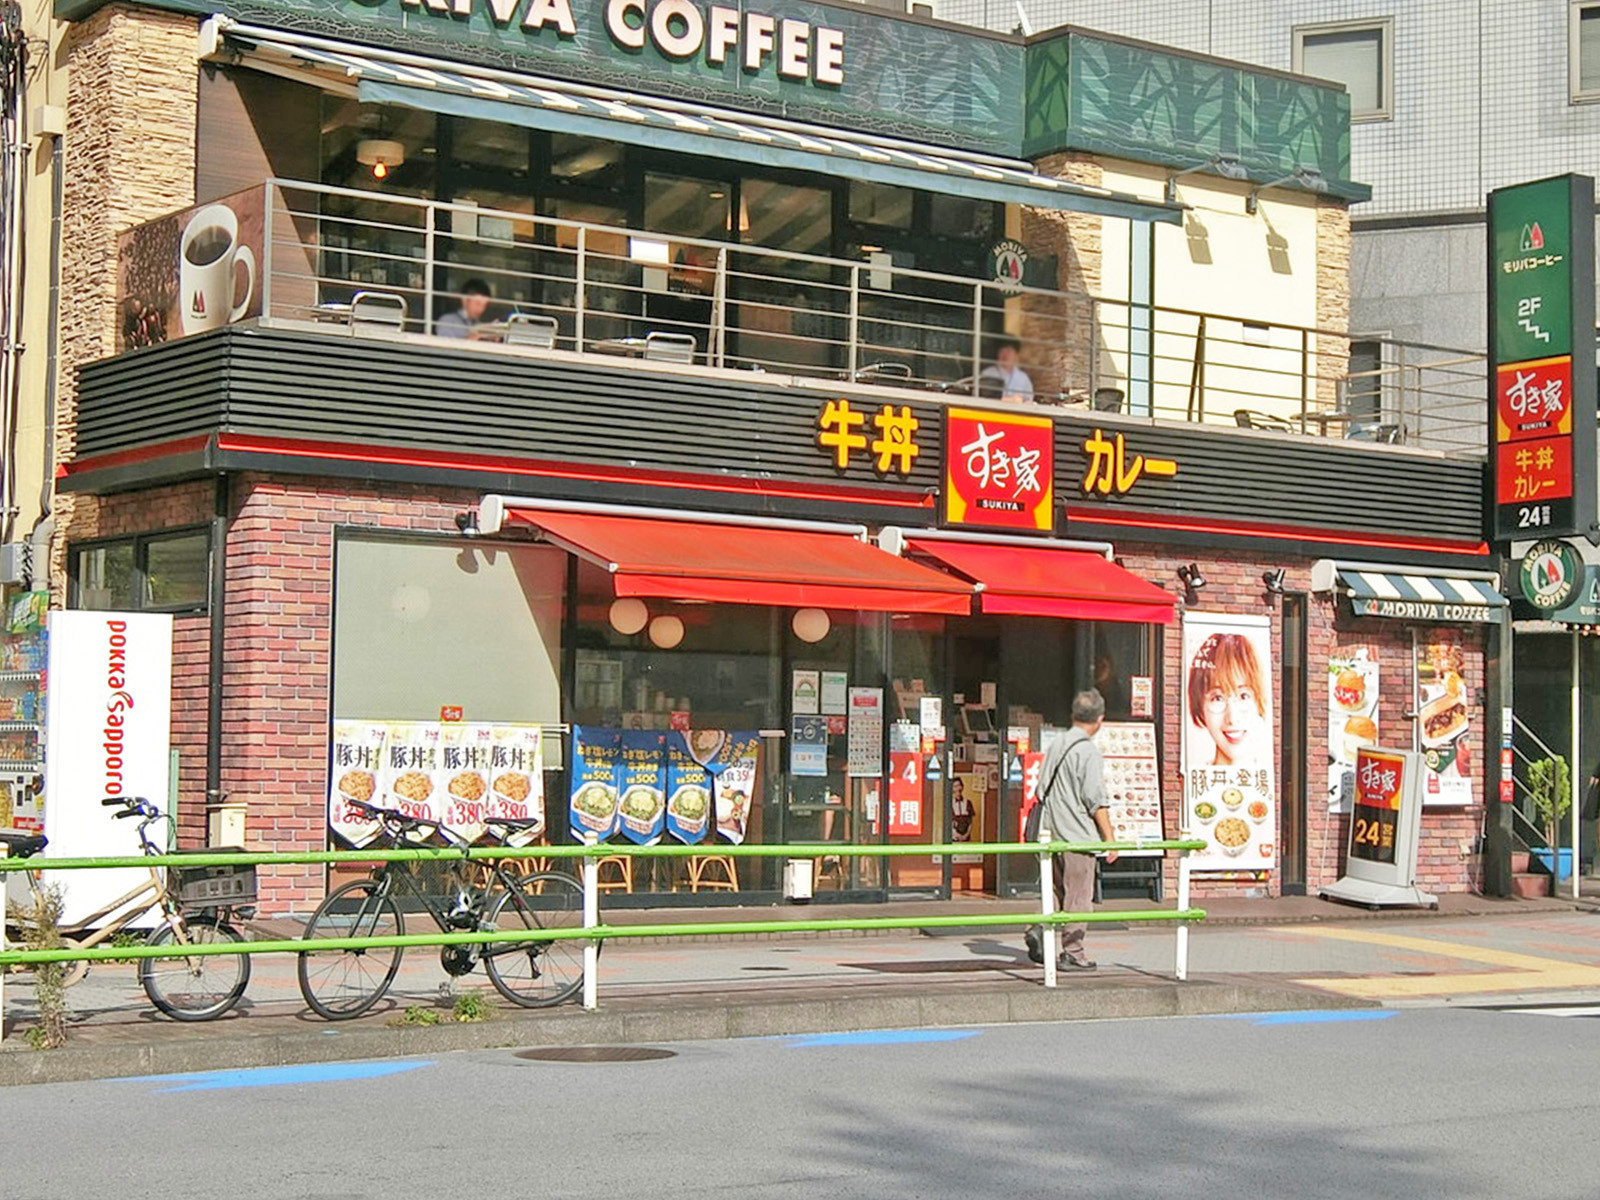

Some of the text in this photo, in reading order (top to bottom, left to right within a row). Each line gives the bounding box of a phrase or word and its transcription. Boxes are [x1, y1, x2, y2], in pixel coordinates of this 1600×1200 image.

[604, 0, 845, 85] COFFEE
[1503, 254, 1563, 274] モリバコーヒー
[1518, 297, 1542, 317] 2F
[1506, 371, 1564, 419] すき家
[819, 398, 920, 474] 牛丼
[961, 422, 1041, 499] すき家
[1084, 429, 1178, 494] カレー
[1515, 446, 1554, 472] 牛丼
[1514, 475, 1556, 498] カレー
[982, 500, 1019, 511] SUKIYA
[1523, 541, 1563, 571] MORIVA
[1534, 582, 1571, 608] COFFEE
[1381, 602, 1491, 621] MORIVA COFFEE
[336, 743, 373, 768] 豚丼
[390, 745, 426, 768] 豚丼
[443, 746, 479, 769] 豚丼
[491, 745, 526, 770] 豚丼
[1360, 758, 1396, 793] すき家
[456, 803, 485, 825] 380
[499, 801, 528, 819] 380
